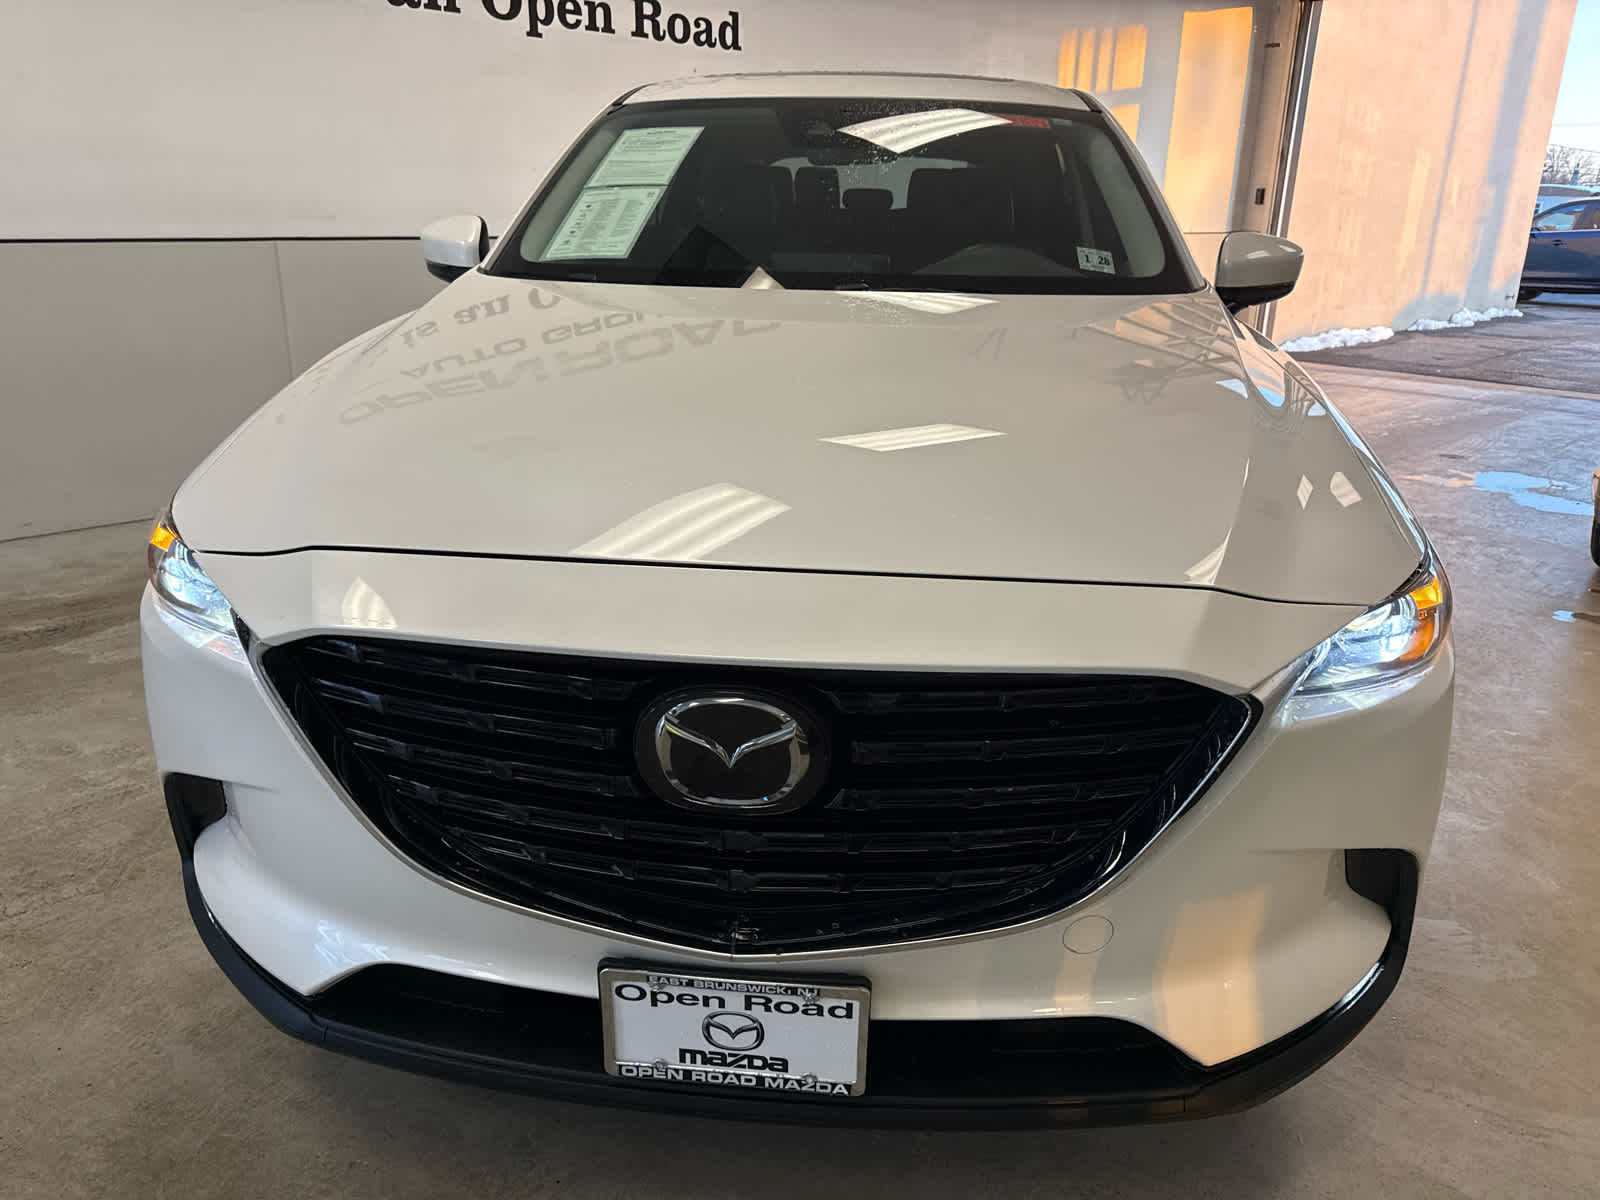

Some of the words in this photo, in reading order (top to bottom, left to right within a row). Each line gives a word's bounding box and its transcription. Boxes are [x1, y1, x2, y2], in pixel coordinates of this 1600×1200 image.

[631, 0, 741, 50] Road
[648, 975, 688, 987] EAST
[614, 984, 726, 1008] Open
[744, 994, 853, 1019] Road
[621, 1065, 683, 1081] OPEN
[691, 1070, 756, 1086] ROAD
[765, 1077, 848, 1095] MAZDA
